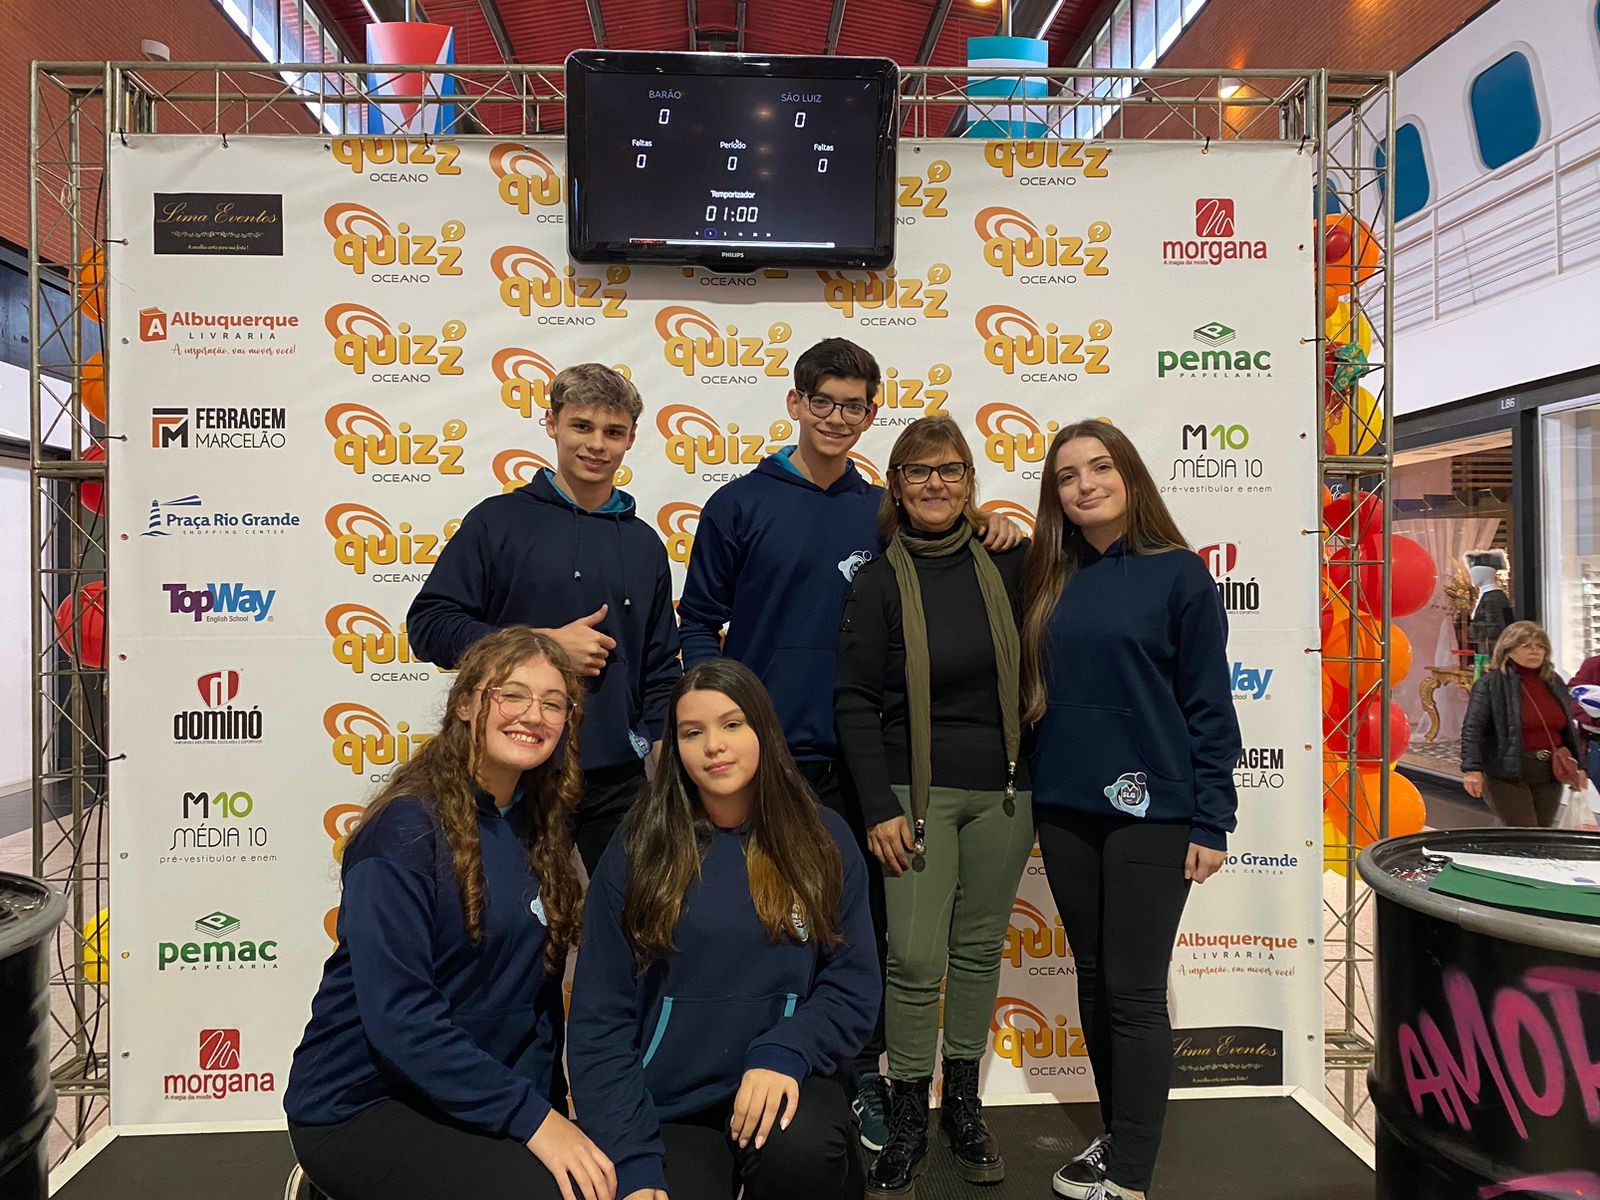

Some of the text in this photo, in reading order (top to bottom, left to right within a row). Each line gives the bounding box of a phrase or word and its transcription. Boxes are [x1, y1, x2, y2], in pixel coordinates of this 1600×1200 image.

[649, 88, 681, 100] BARÃO
[781, 92, 822, 103] SÃO LUIZ
[658, 108, 670, 125] 0
[794, 112, 806, 128] 0
[632, 139, 652, 147] Faltas
[720, 140, 746, 150] Período
[814, 143, 834, 152] Faltas
[636, 154, 647, 169] 0
[727, 156, 738, 171] 0
[818, 158, 828, 173] 0
[369, 173, 429, 183] OCEANO
[1019, 177, 1076, 186] OCEANO
[710, 190, 756, 200] Temporizador
[157, 202, 278, 224] Lima Eventos
[705, 205, 759, 223] 01:00
[721, 251, 744, 259] PHILIPS
[1163, 240, 1268, 266] morgana
[371, 274, 430, 283] OCEANO
[700, 277, 756, 286] OCEANO
[1020, 275, 1077, 284] OCEANO
[171, 311, 299, 330] Albuquerque
[537, 316, 595, 326] OCEANO
[860, 317, 917, 326] OCEANO
[189, 332, 276, 340] LIVRARIA
[1158, 350, 1271, 379] pemac
[371, 373, 431, 383] OCEANO
[701, 375, 757, 384] OCEANO
[1020, 373, 1078, 382] OCEANO
[196, 408, 286, 429] FERRAGEM
[195, 430, 286, 449] MARCELÃO
[1169, 454, 1263, 481] MÉDIA 10
[372, 473, 431, 483] OCEANO
[1160, 485, 1234, 494] pré-vestibular
[167, 513, 300, 529] Praça Rio Grande
[162, 583, 276, 623] TopWay
[206, 615, 228, 623] English
[370, 672, 430, 682] OCEANO
[174, 705, 263, 740] dominó
[1232, 770, 1284, 788] CELÃO
[170, 823, 267, 850] MÉDIA 10
[160, 854, 236, 864] pré-vestibular
[251, 854, 277, 862] enem
[1241, 853, 1298, 867] Grande
[1176, 933, 1297, 951] Albuquerque
[159, 940, 278, 971] pemac
[1193, 951, 1274, 960] LIVRARIA
[180, 963, 278, 971] PAPELARIA
[1028, 967, 1076, 976] OCEAN
[1216, 1035, 1278, 1057] Eventos
[1029, 1066, 1087, 1076] OCEANO
[164, 1072, 274, 1099] morgana
